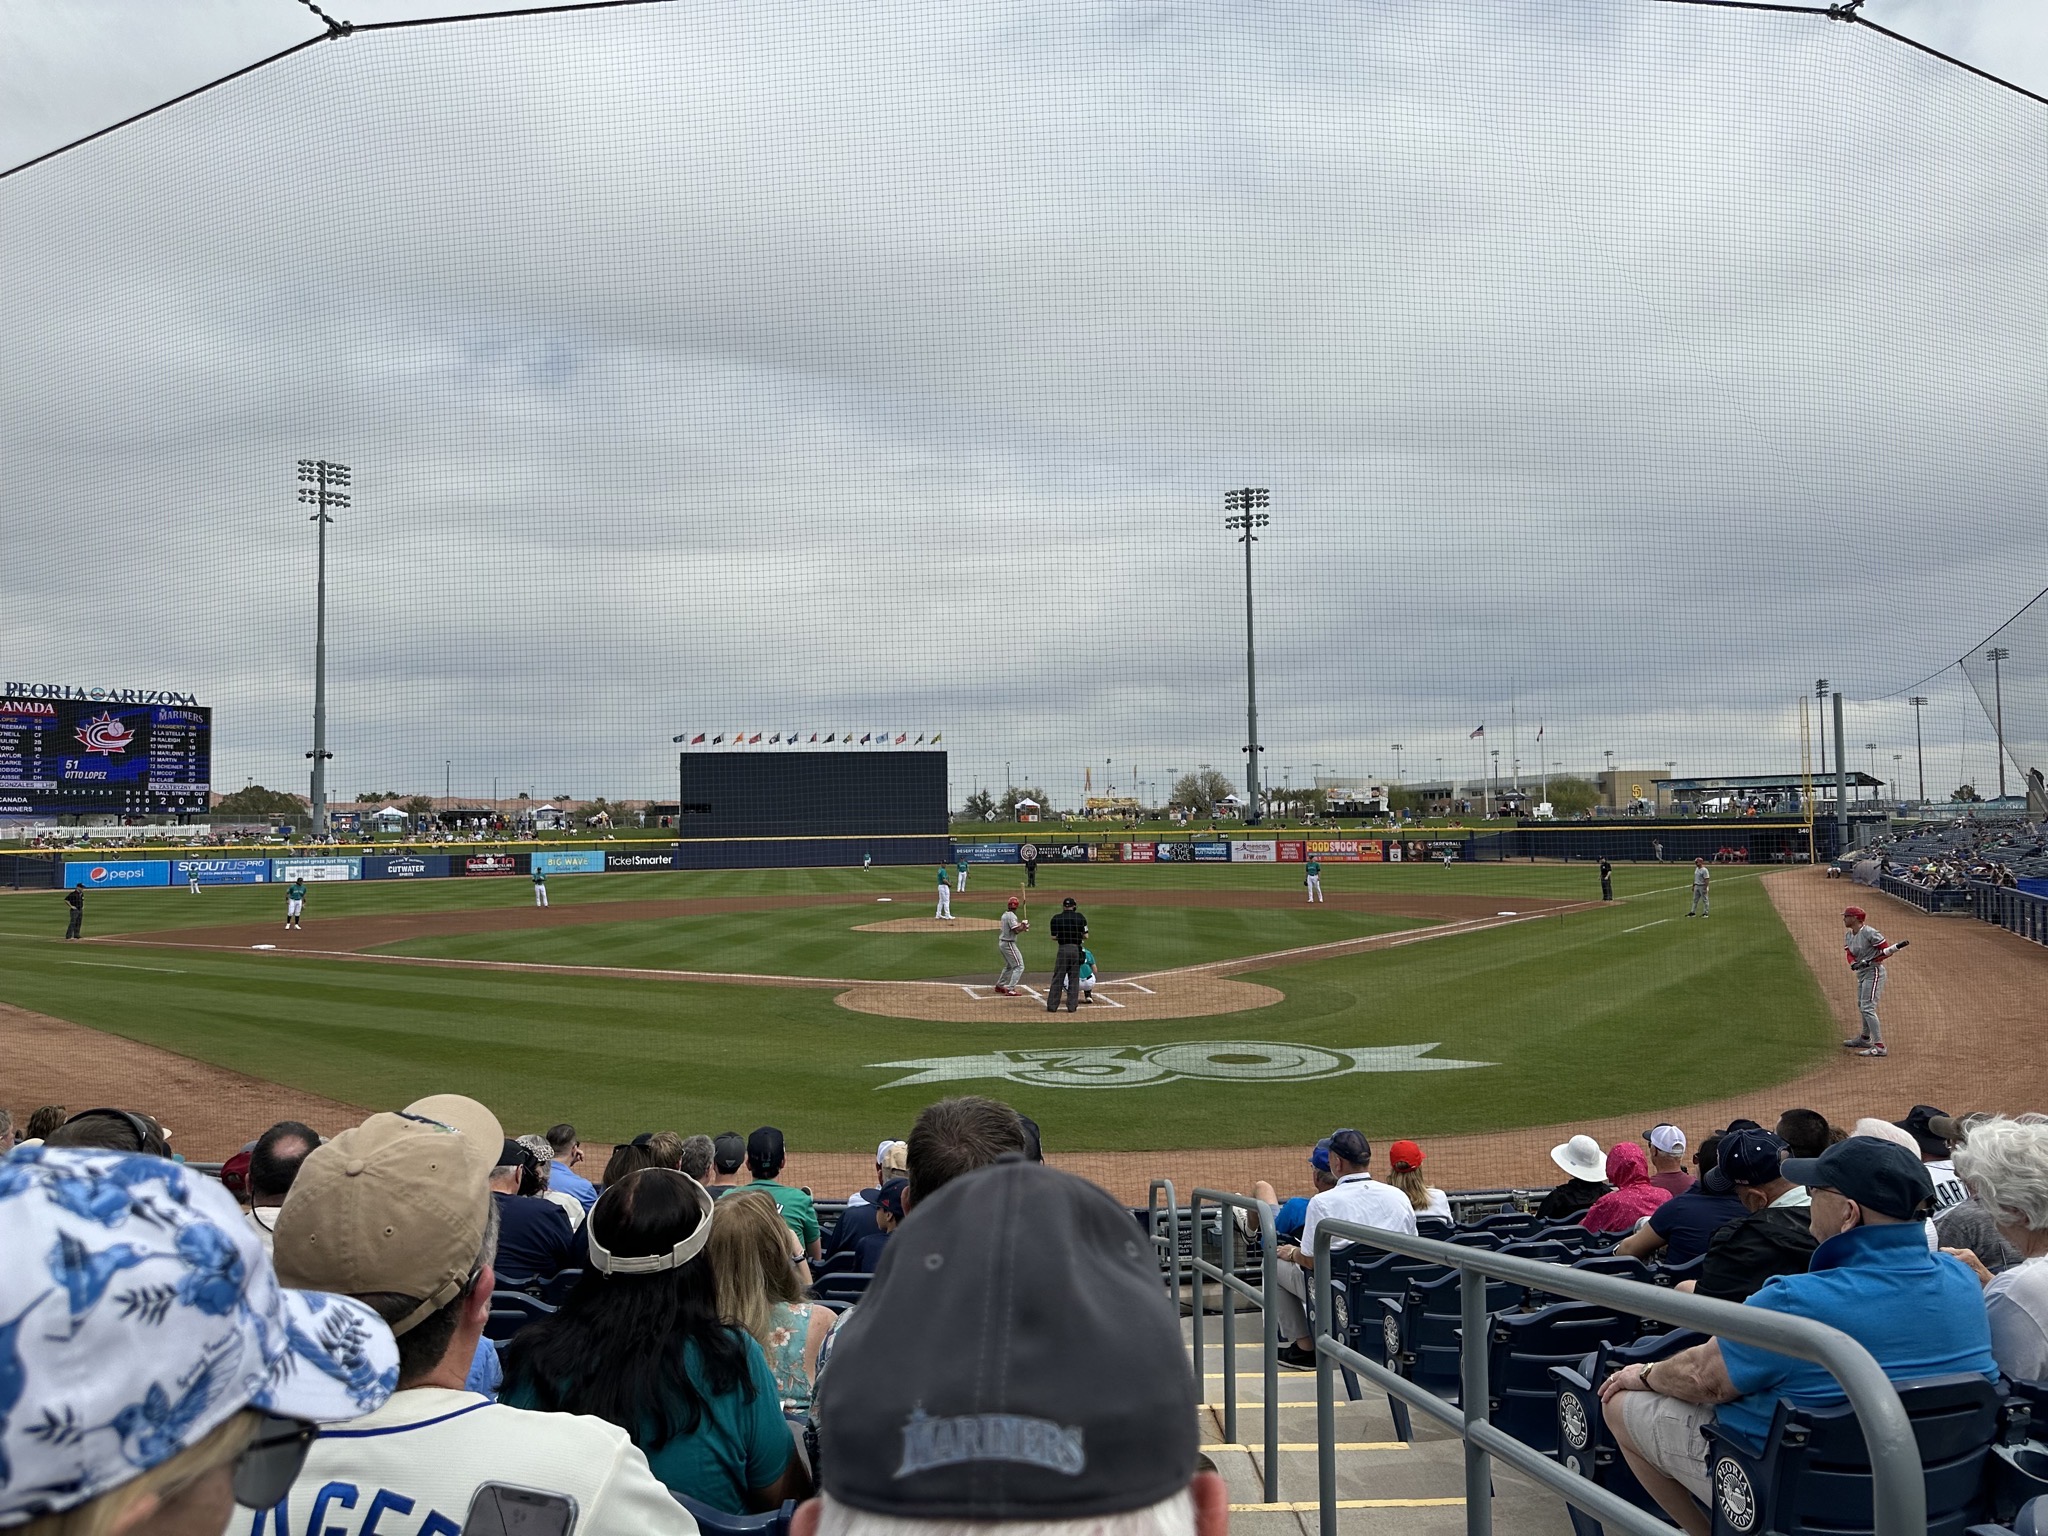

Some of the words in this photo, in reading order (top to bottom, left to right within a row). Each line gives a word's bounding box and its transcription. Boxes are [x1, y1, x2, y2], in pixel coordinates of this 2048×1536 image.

[5, 682, 87, 701] PEORIA
[107, 688, 199, 707] ARIZONA
[0, 701, 55, 714] ANADA
[158, 710, 204, 724] MARINERS
[65, 760, 79, 769] 51
[64, 771, 84, 779] OTTO
[84, 771, 107, 780] LOPEZ
[160, 797, 167, 805] 2
[178, 797, 185, 805] 0
[197, 797, 204, 805] 0
[1306, 841, 1358, 852] FOODSTOCK
[608, 855, 673, 866] TicketSmarter
[109, 868, 144, 880] pepsi
[388, 865, 425, 873] CUTWATER
[1562, 1396, 1583, 1419] PEORIA
[893, 1405, 1085, 1478] MARINERS
[1718, 1462, 1748, 1491] PEORIA
[1719, 1495, 1753, 1526] ARIZONA
